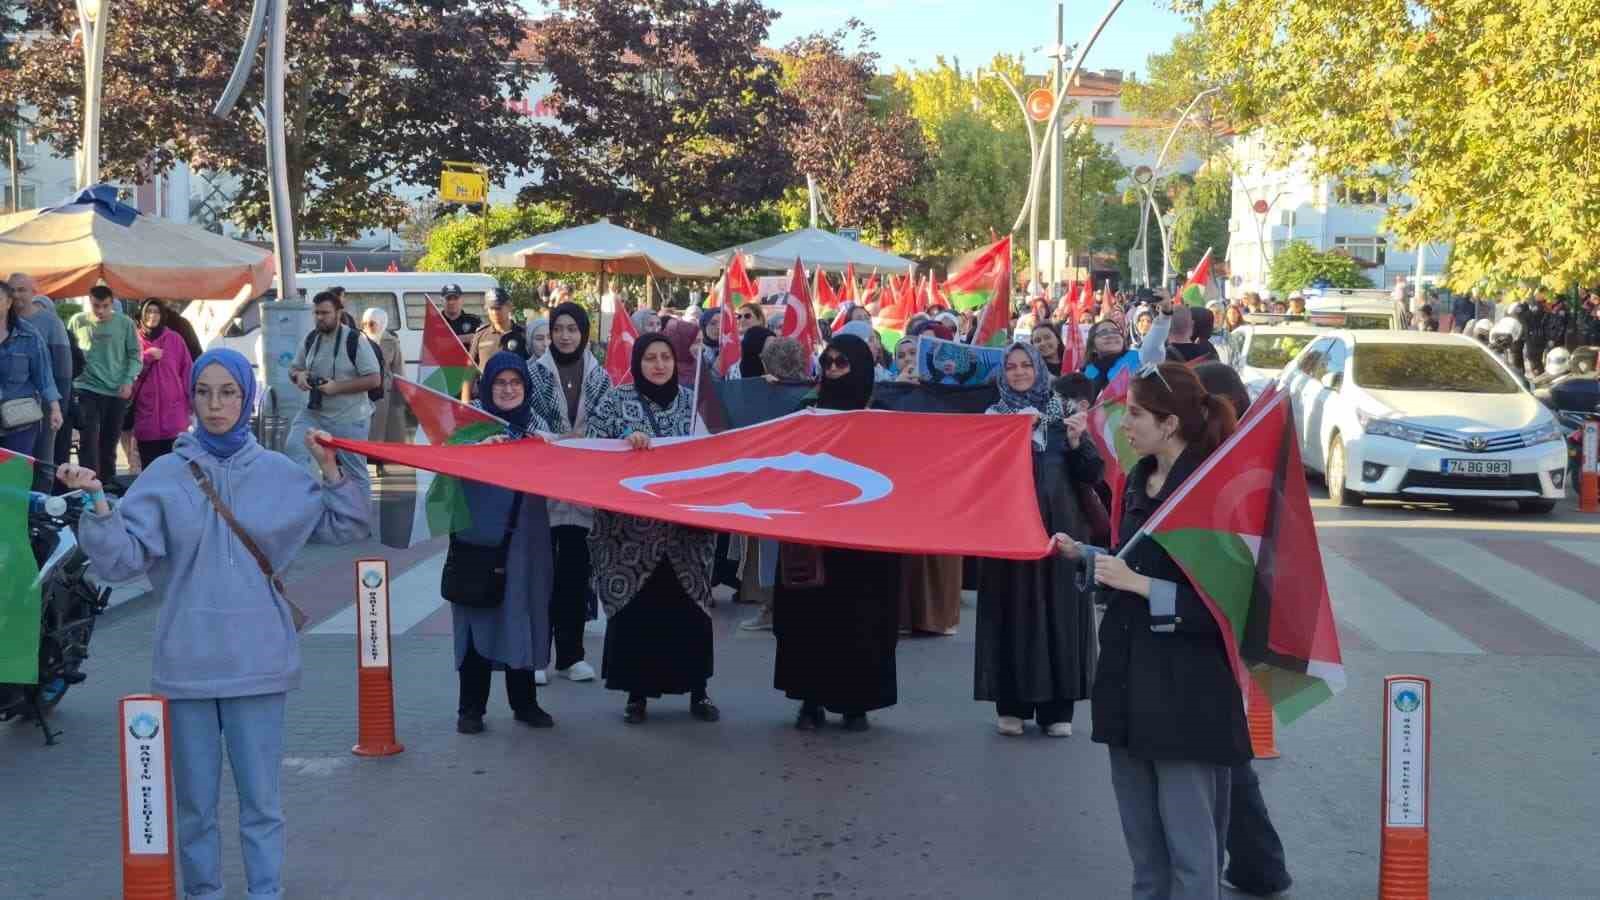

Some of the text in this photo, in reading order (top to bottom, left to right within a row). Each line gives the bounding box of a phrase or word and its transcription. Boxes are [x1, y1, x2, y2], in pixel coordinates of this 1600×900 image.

[1450, 461, 1508, 473] 74 BG 983
[140, 744, 152, 780] BARTIN
